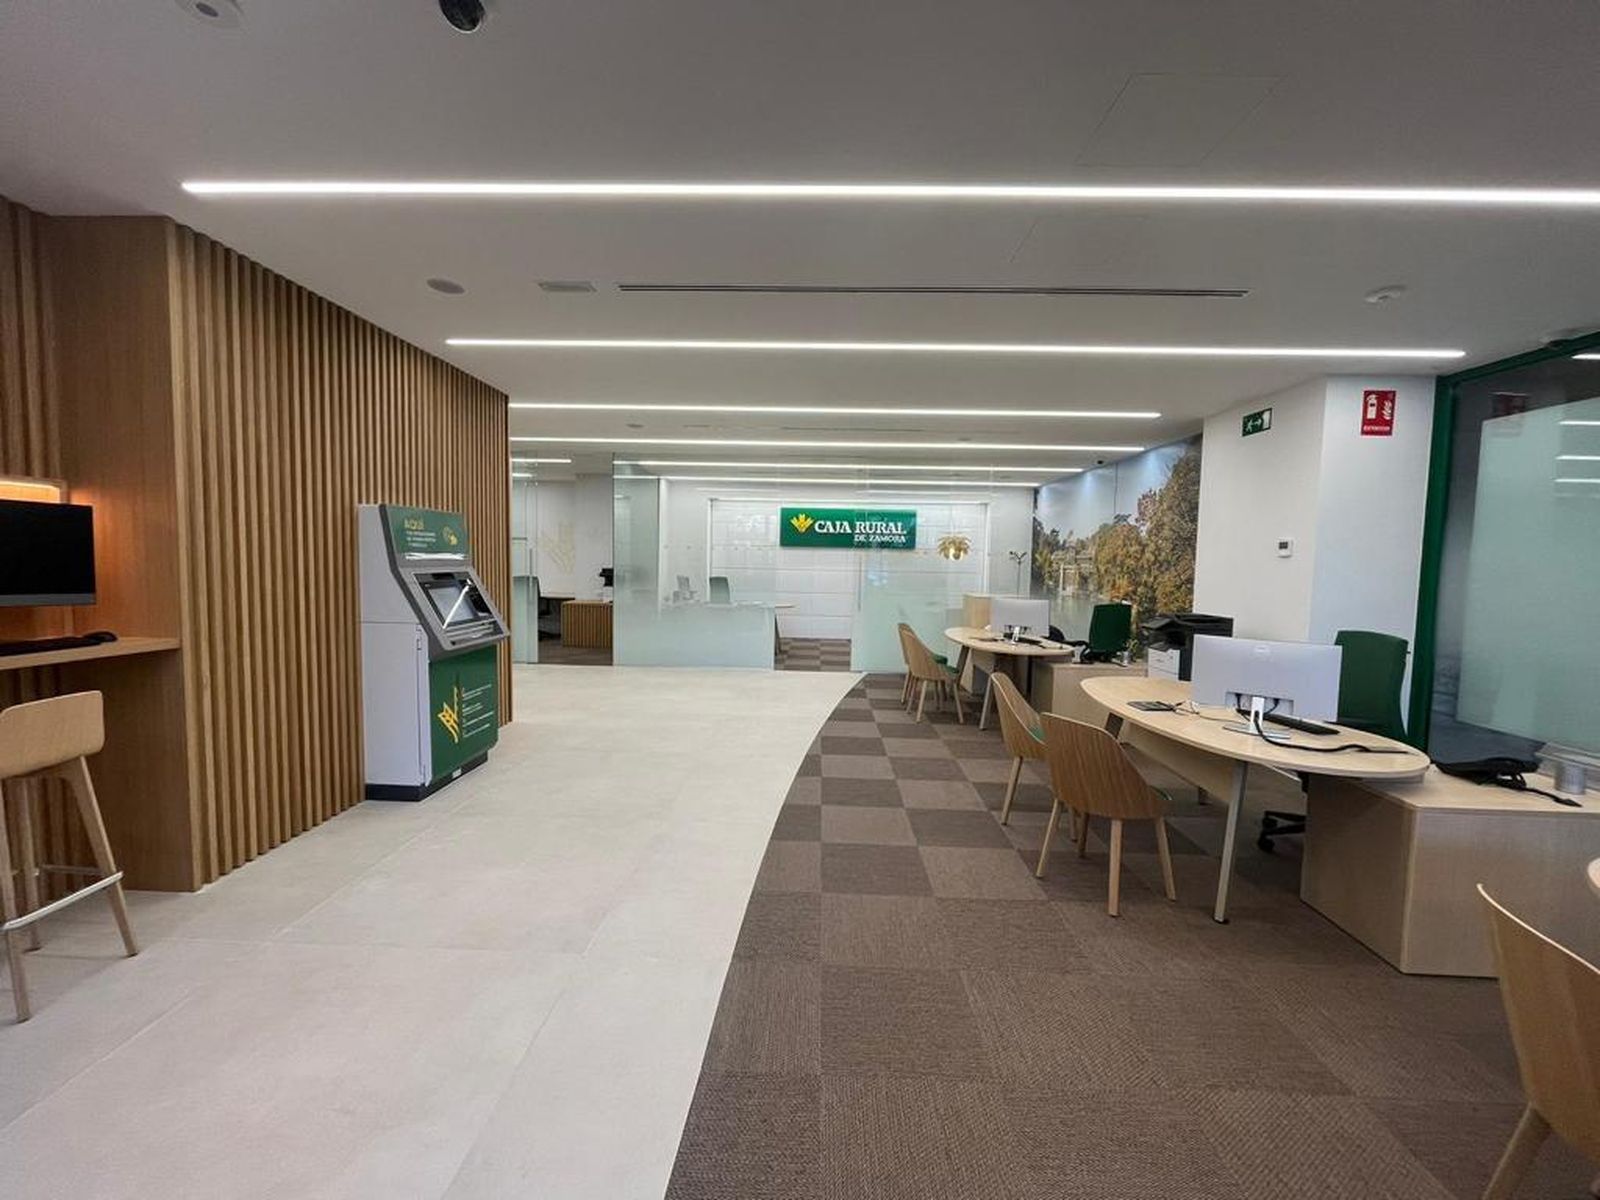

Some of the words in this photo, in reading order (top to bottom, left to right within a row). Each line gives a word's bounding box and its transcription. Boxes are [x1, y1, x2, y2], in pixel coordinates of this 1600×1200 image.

[814, 521, 852, 534] CAJA
[855, 521, 907, 535] RURAL
[854, 534, 867, 542] DE
[869, 535, 906, 543] ZAMORA
